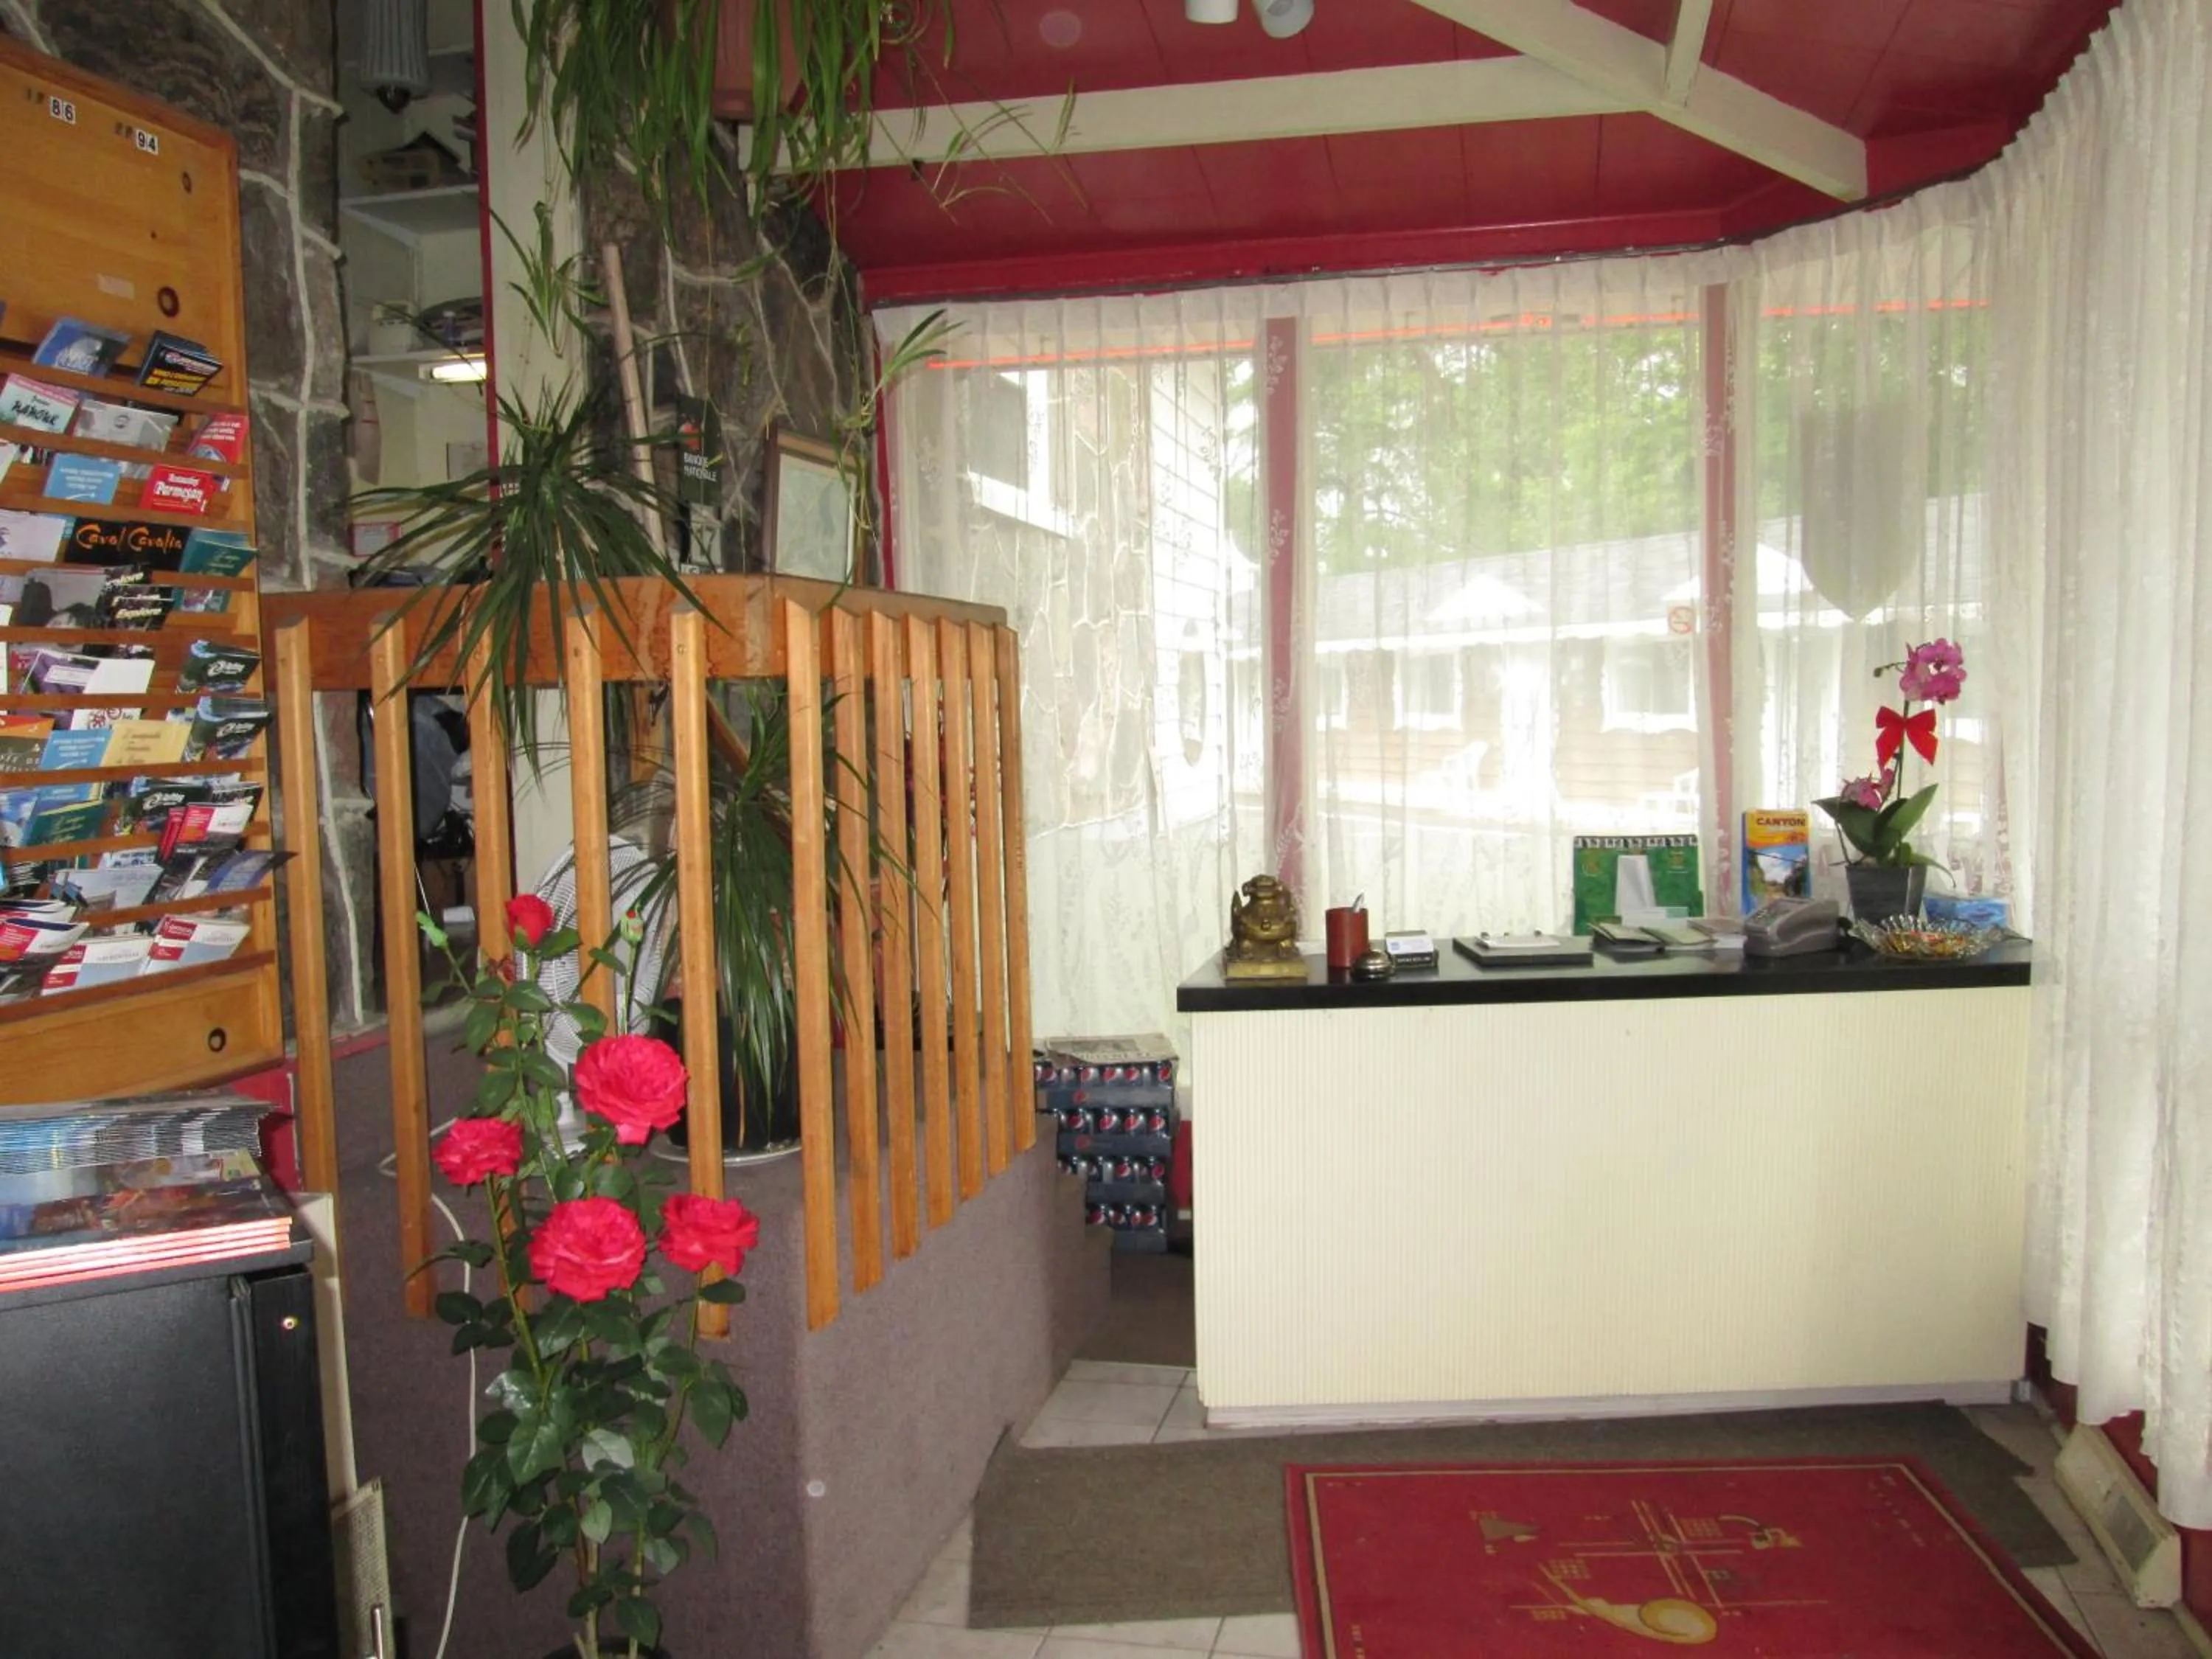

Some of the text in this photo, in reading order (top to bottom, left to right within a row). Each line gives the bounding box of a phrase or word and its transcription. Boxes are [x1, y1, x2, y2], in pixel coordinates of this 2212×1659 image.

[52, 99, 72, 121] 86
[138, 131, 156, 151] 94
[1756, 816, 1806, 827] CANYON
